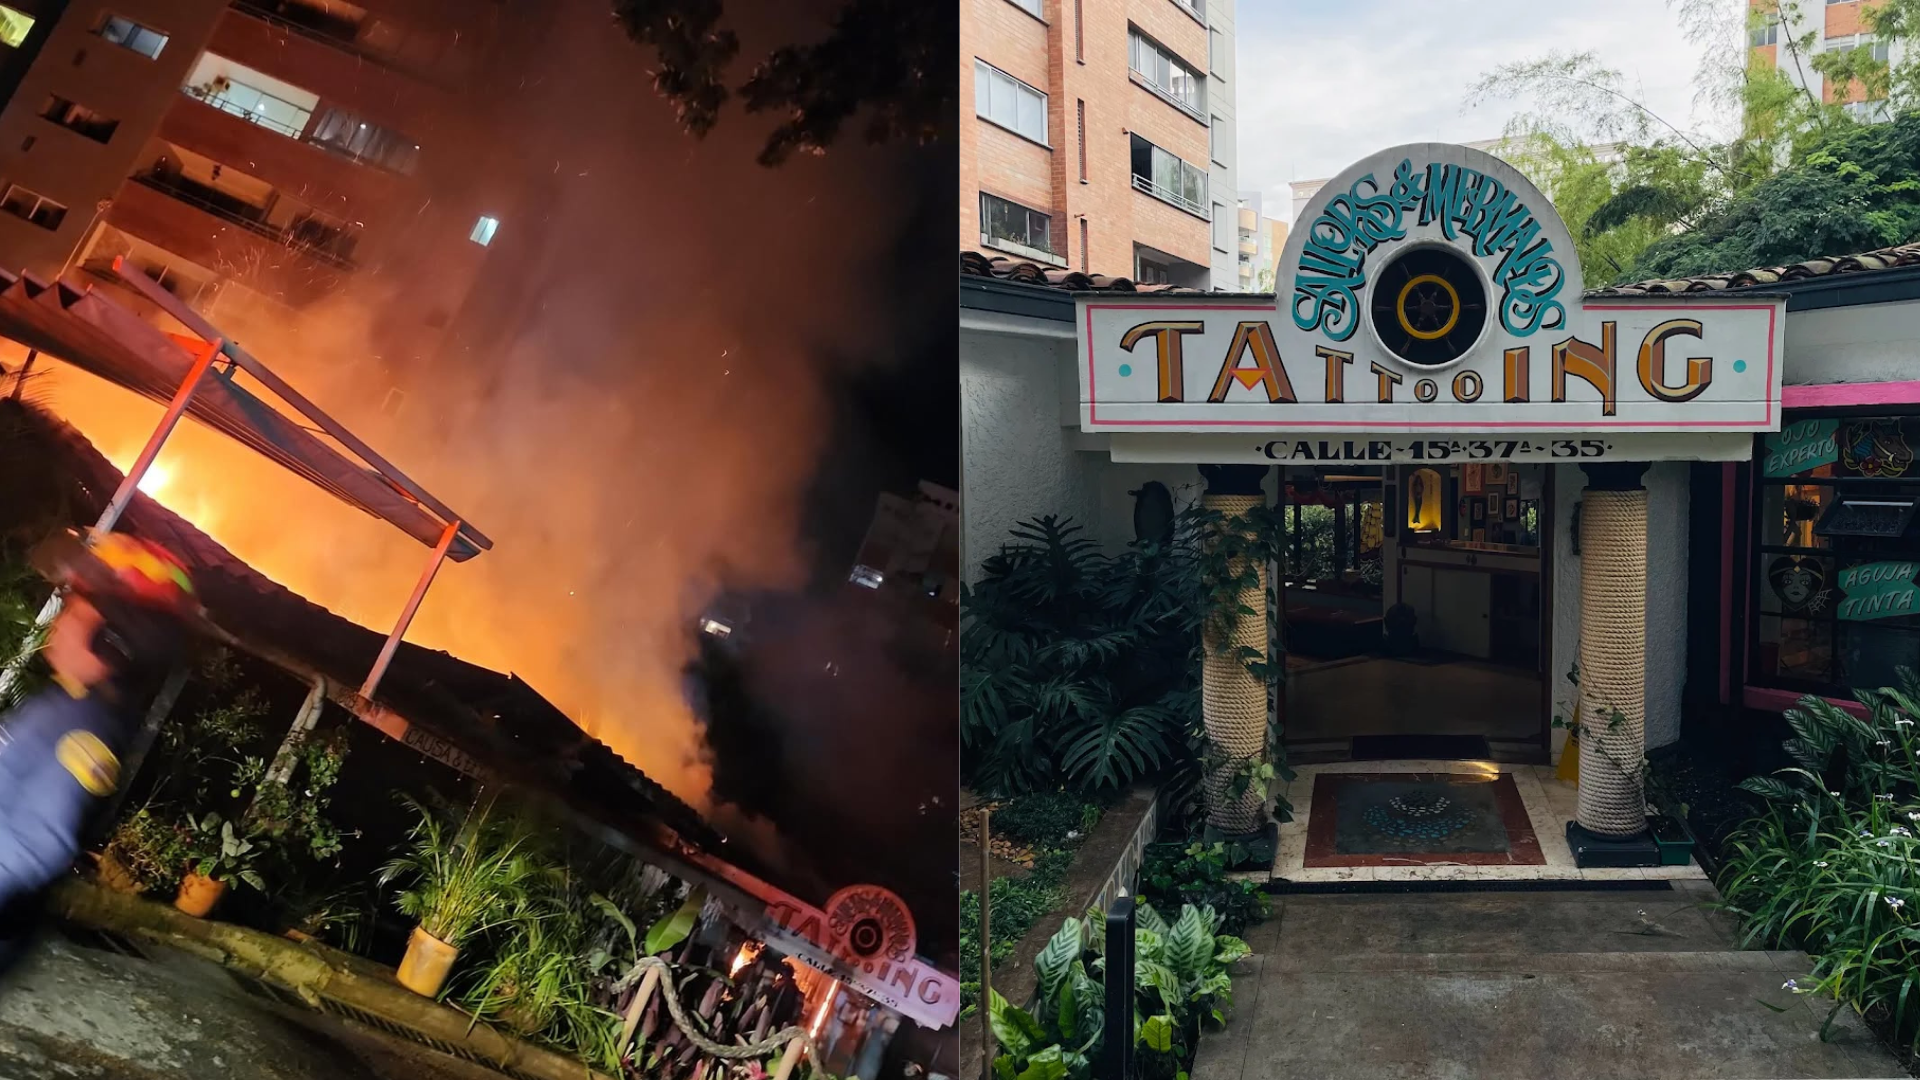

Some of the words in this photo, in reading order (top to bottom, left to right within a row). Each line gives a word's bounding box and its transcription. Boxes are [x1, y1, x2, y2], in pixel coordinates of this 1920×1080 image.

[1291, 172, 1408, 342] SAILORS
[1389, 158, 1432, 211] &
[1417, 162, 1567, 338] MERMAIDS
[1119, 318, 1713, 417] TATTOOING
[1781, 420, 1820, 445] OJO
[1769, 437, 1836, 473] EXPERTO
[1845, 563, 1913, 589] AGUJA
[1845, 589, 1915, 617] TINTA
[404, 728, 450, 762] CAUSA
